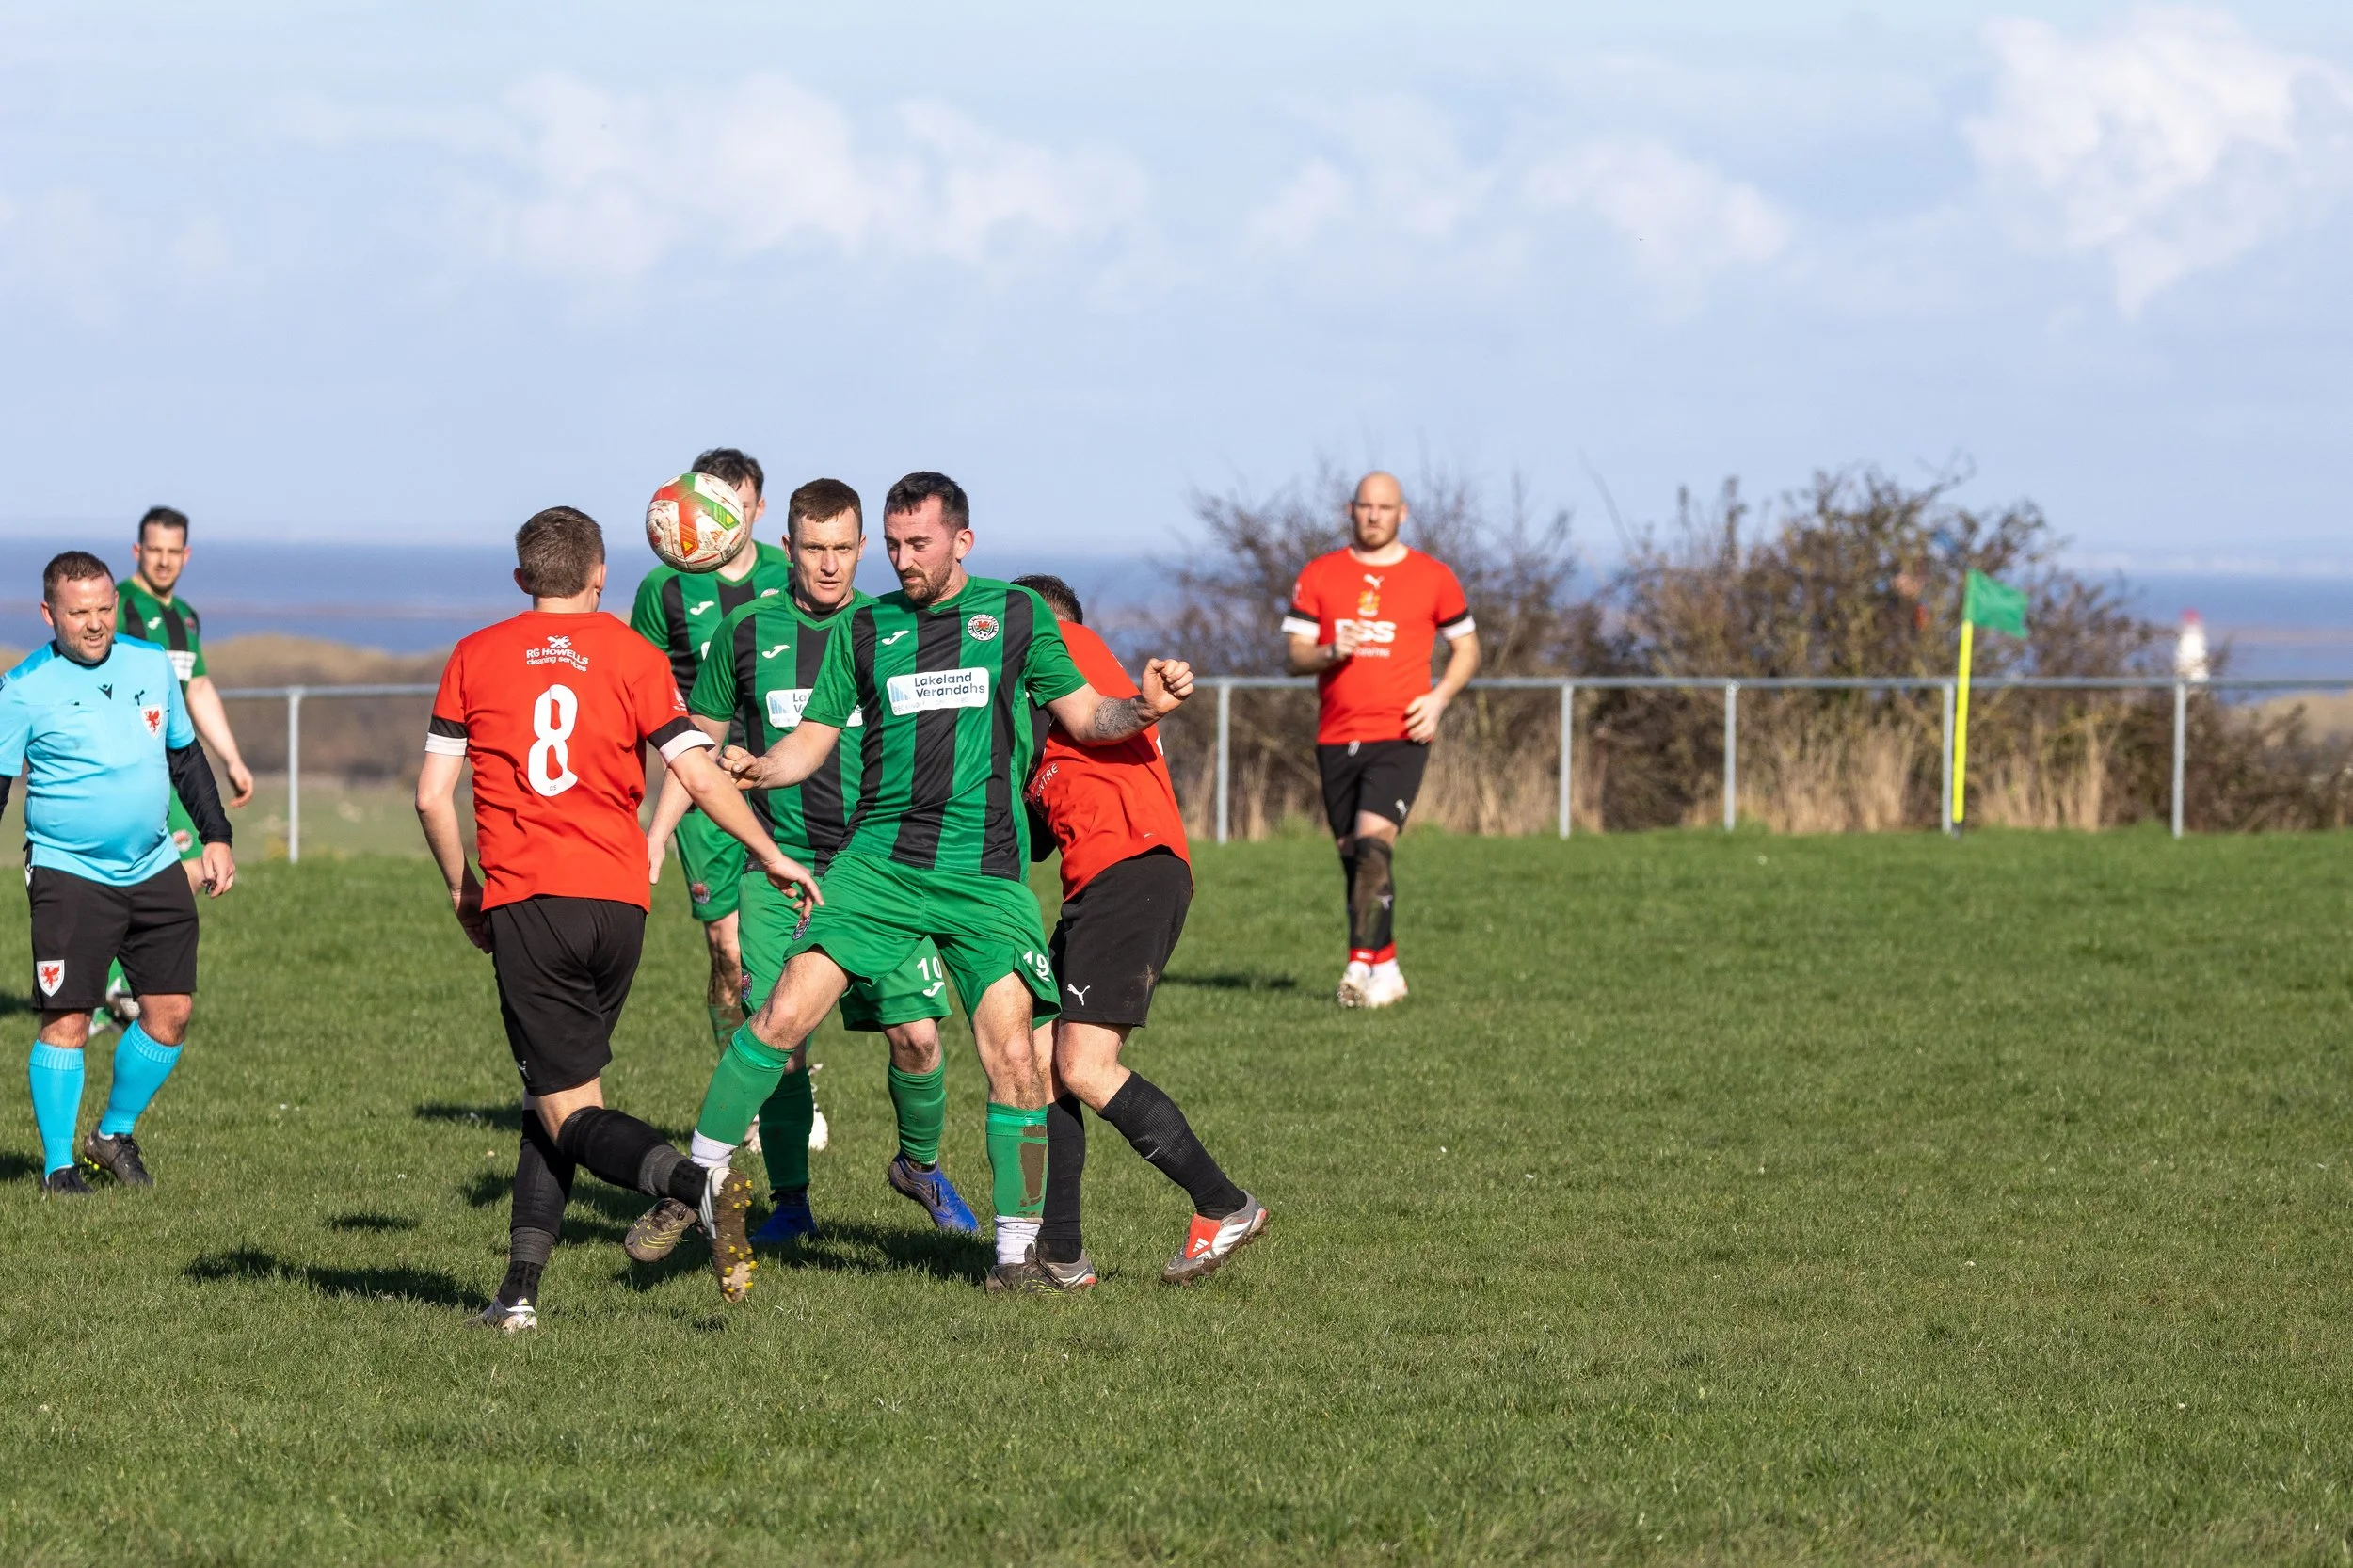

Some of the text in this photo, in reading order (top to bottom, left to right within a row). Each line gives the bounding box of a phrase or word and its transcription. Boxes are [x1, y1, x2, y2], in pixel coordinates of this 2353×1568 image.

[526, 648, 589, 665] RG HOWELLS
[526, 655, 587, 672] cleaning services
[914, 672, 972, 688] Lakeland
[916, 682, 985, 698] Verandahs
[527, 683, 579, 797] 8
[916, 956, 943, 981] 10
[1023, 950, 1050, 977] 19
